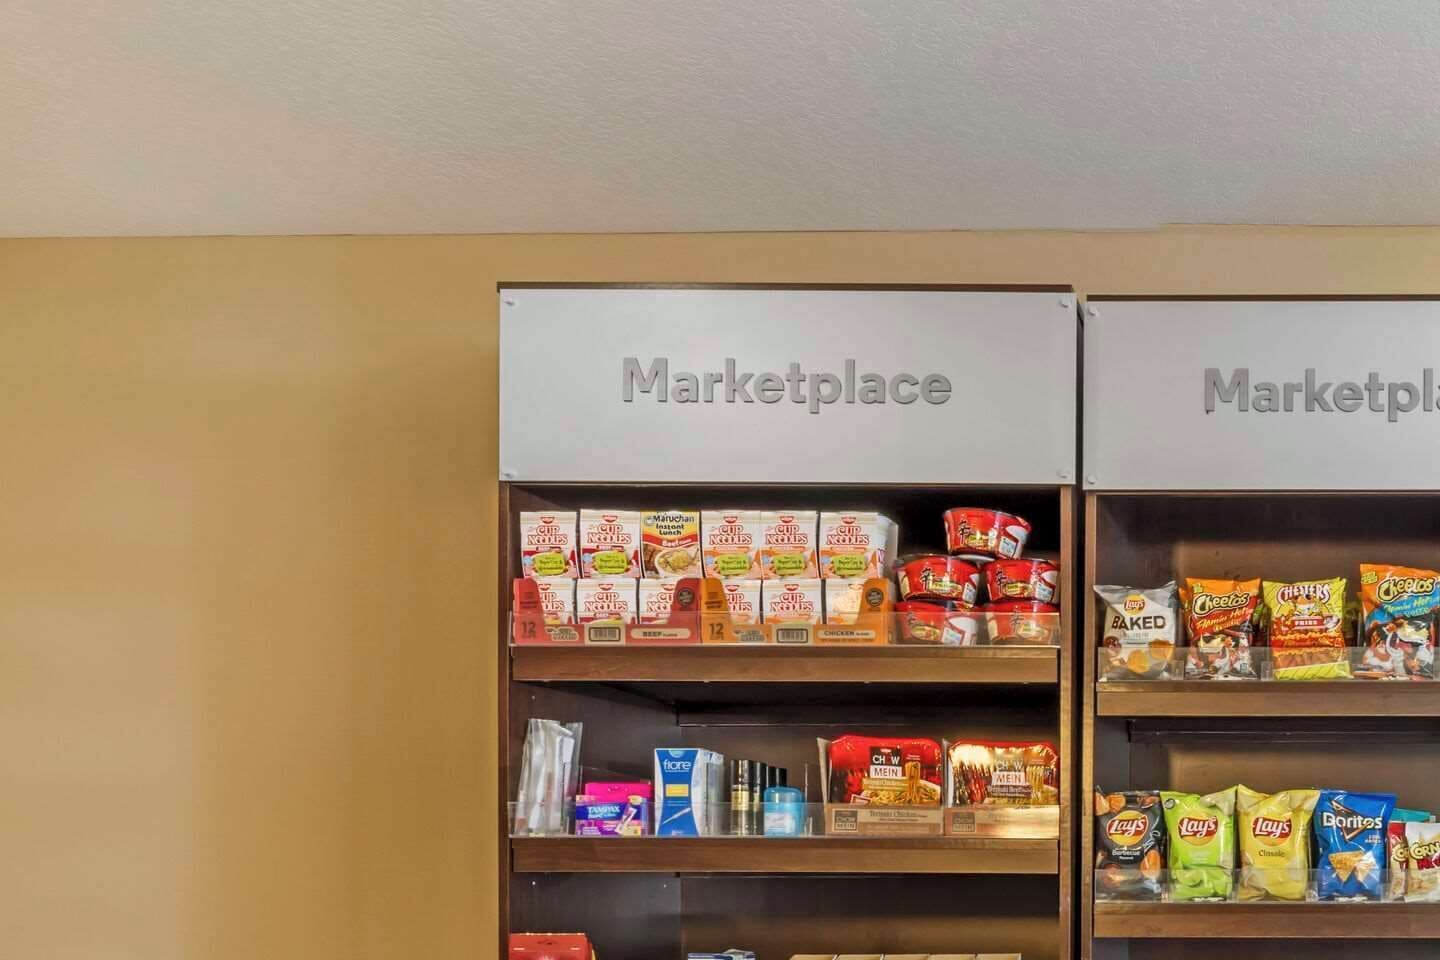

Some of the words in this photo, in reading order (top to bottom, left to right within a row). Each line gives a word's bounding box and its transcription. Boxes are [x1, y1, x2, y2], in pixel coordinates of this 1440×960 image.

[622, 357, 952, 415] Marketplace
[536, 526, 560, 536] CUP
[599, 524, 623, 535] CUP
[719, 525, 743, 535] CUP
[775, 525, 799, 535] CUP
[836, 526, 861, 535] CUP
[528, 534, 568, 545] NOODLES
[587, 533, 631, 544] NOODLES
[709, 534, 752, 545] NOODLES
[765, 534, 808, 545] NOODLES
[827, 535, 869, 545] NOODLES
[1379, 578, 1434, 602] Cheetos
[594, 592, 619, 601] CUP
[780, 593, 805, 602] CUP
[1194, 592, 1250, 616] Cheetos
[521, 622, 536, 633] 12
[1111, 615, 1166, 631] BAKED
[709, 624, 724, 634] 12
[874, 768, 898, 776] MEIN
[1323, 812, 1383, 829] Doritos
[1109, 818, 1145, 836] Lay's
[1181, 817, 1217, 838] Lay's
[1255, 817, 1290, 838] Lay's
[1409, 841, 1440, 860] CORN
